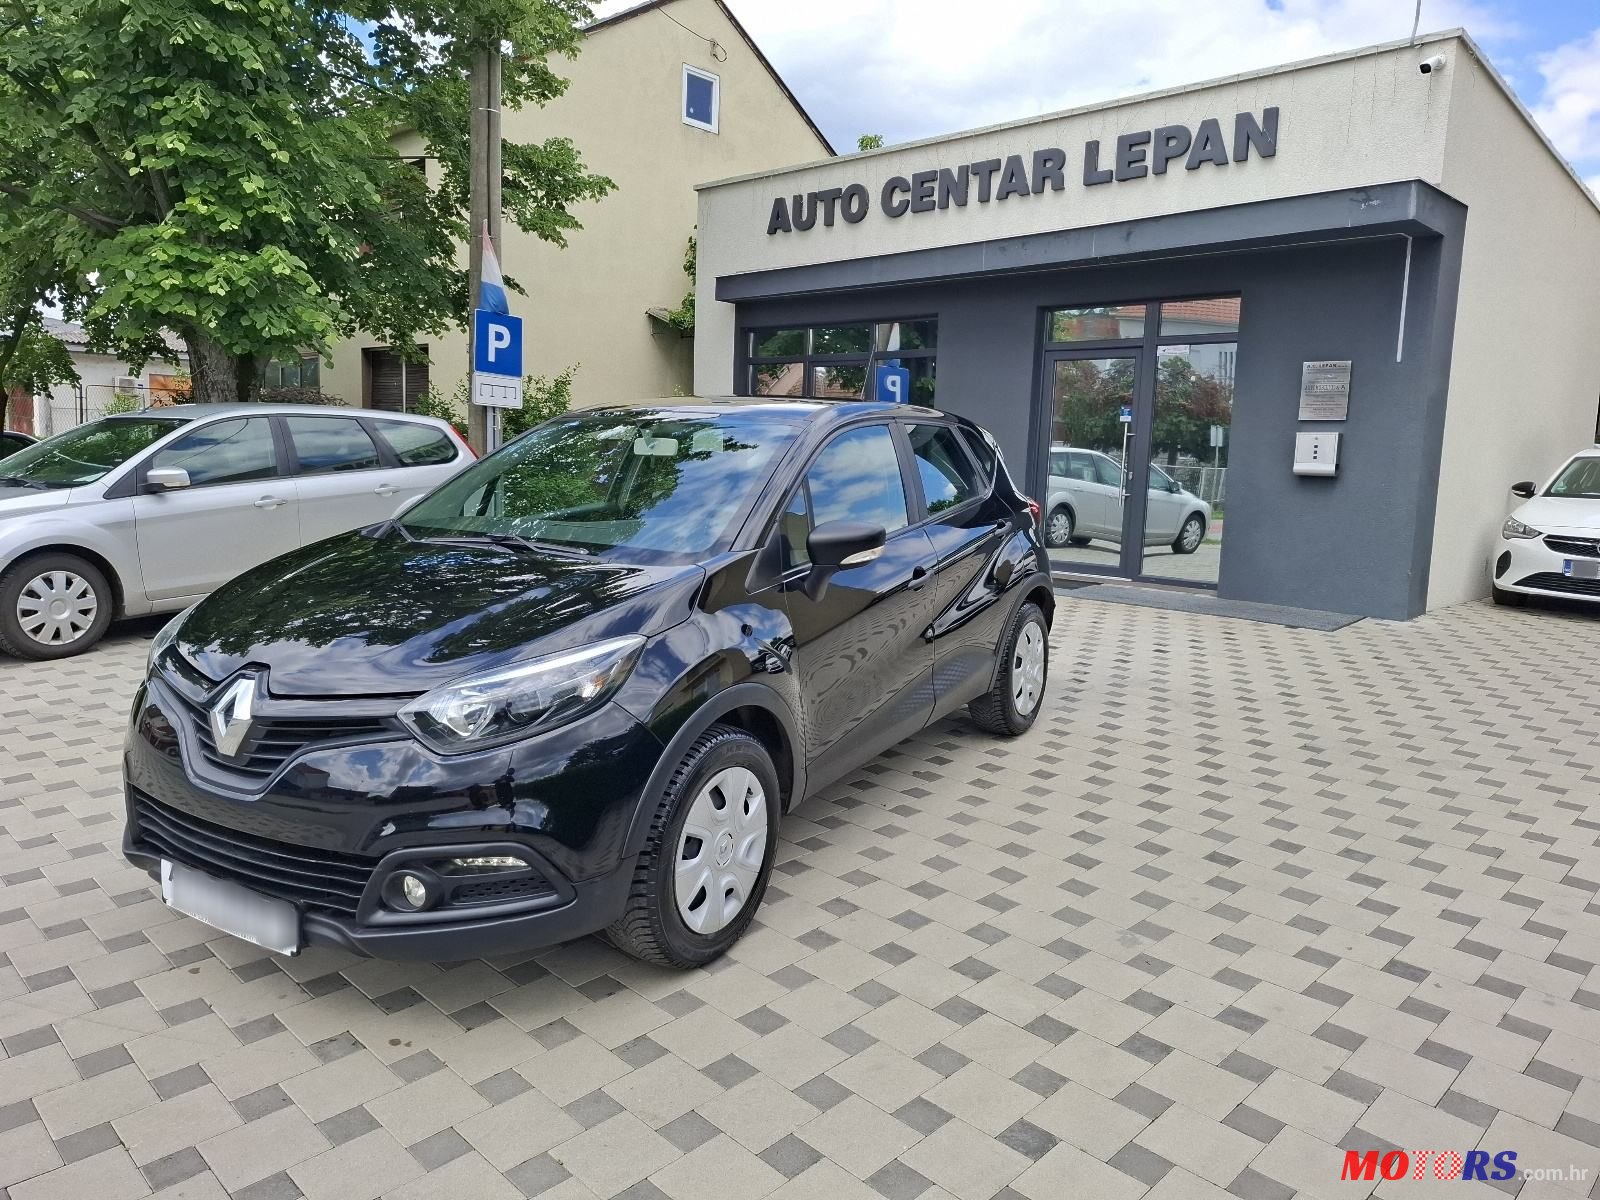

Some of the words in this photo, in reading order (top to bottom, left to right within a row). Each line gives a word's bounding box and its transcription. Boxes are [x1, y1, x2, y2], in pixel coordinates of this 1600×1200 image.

[766, 183, 870, 235] AUTO
[880, 147, 1067, 219] CENTAR
[1082, 106, 1280, 187] LEPAN
[488, 323, 511, 363] P
